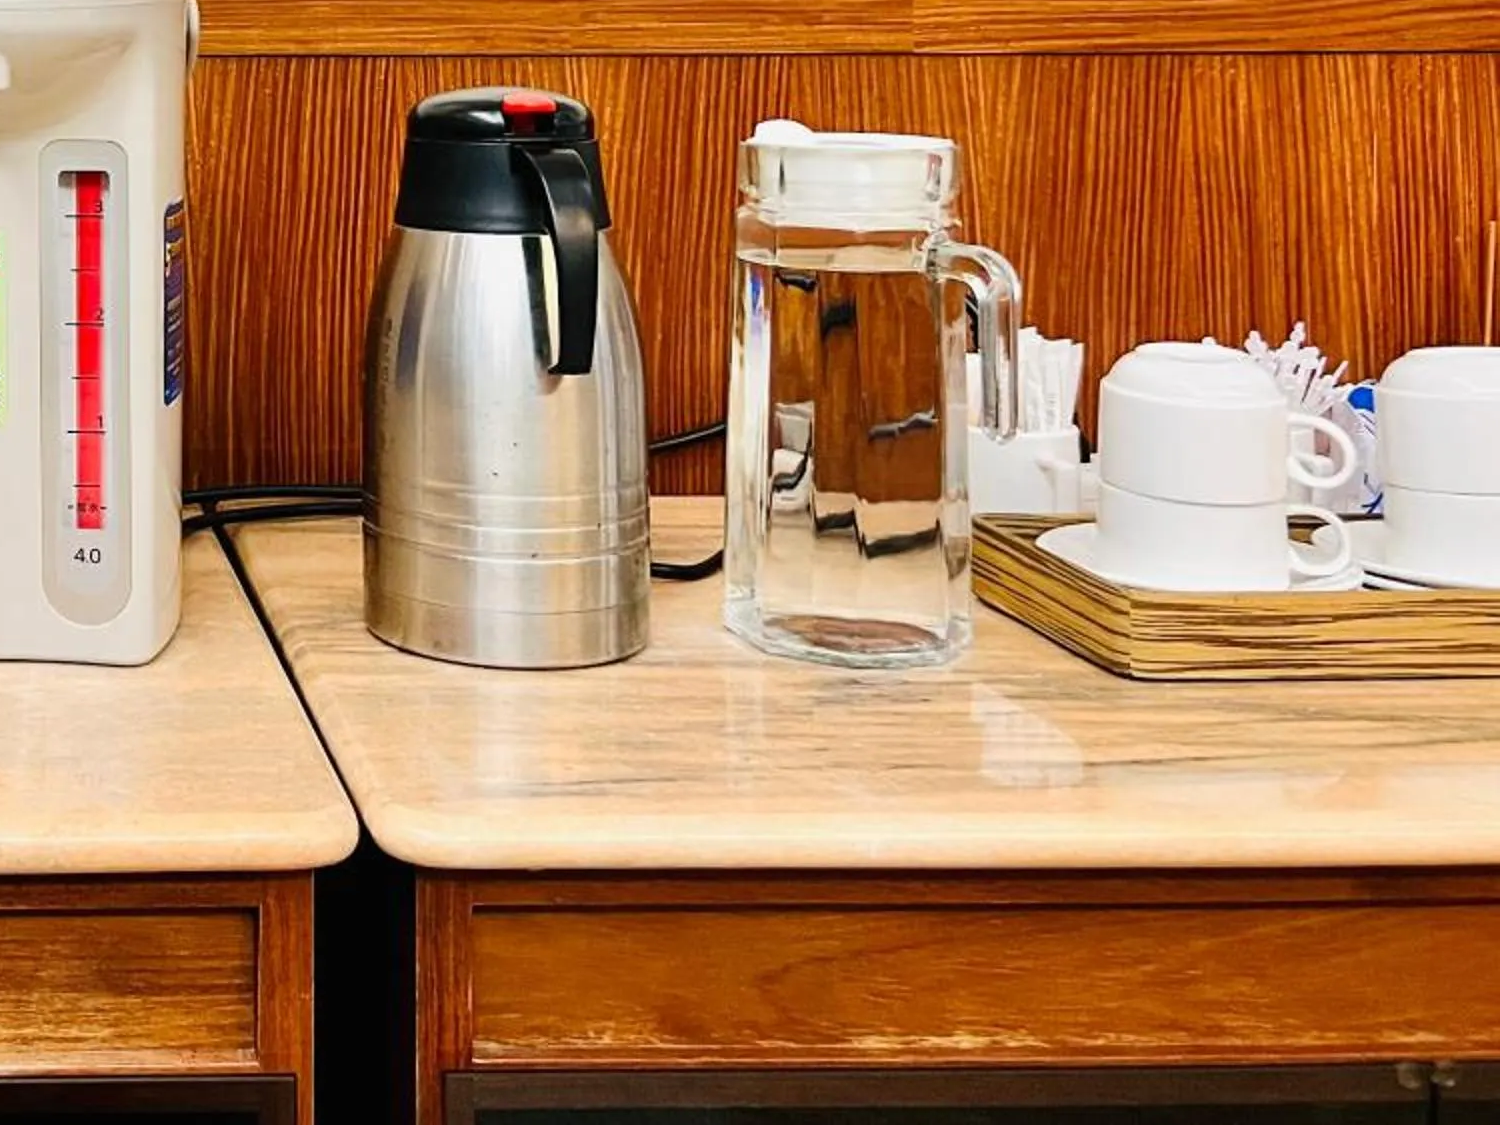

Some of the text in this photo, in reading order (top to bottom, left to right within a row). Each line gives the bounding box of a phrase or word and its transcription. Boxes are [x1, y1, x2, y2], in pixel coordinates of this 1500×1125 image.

[93, 199, 103, 213] 3
[94, 306, 104, 321] 2
[96, 414, 104, 428] 1
[73, 547, 102, 564] 4.0
